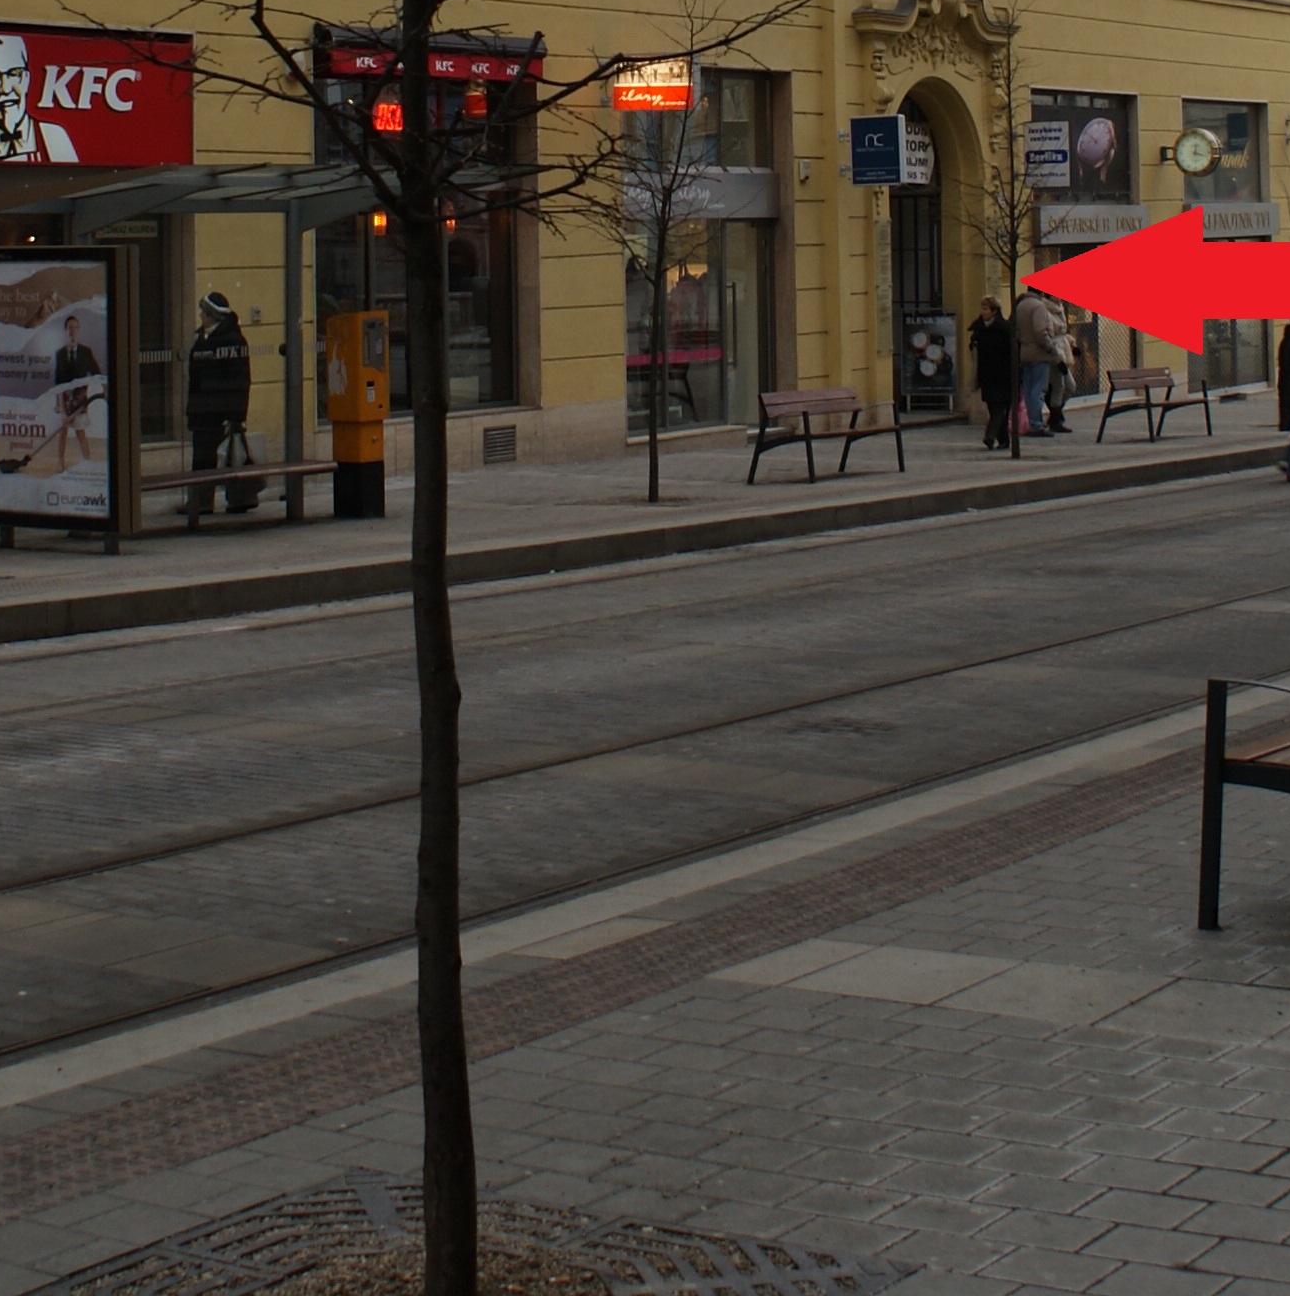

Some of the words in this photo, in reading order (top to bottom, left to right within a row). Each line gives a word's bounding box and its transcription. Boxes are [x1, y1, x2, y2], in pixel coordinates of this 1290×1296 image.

[356, 56, 377, 68] KFC
[435, 60, 454, 72] KFC
[471, 62, 490, 74] KFC
[37, 64, 138, 112] KFC
[16, 289, 40, 302] best
[29, 354, 52, 366] your
[31, 368, 51, 379] and
[1, 422, 46, 437] mom
